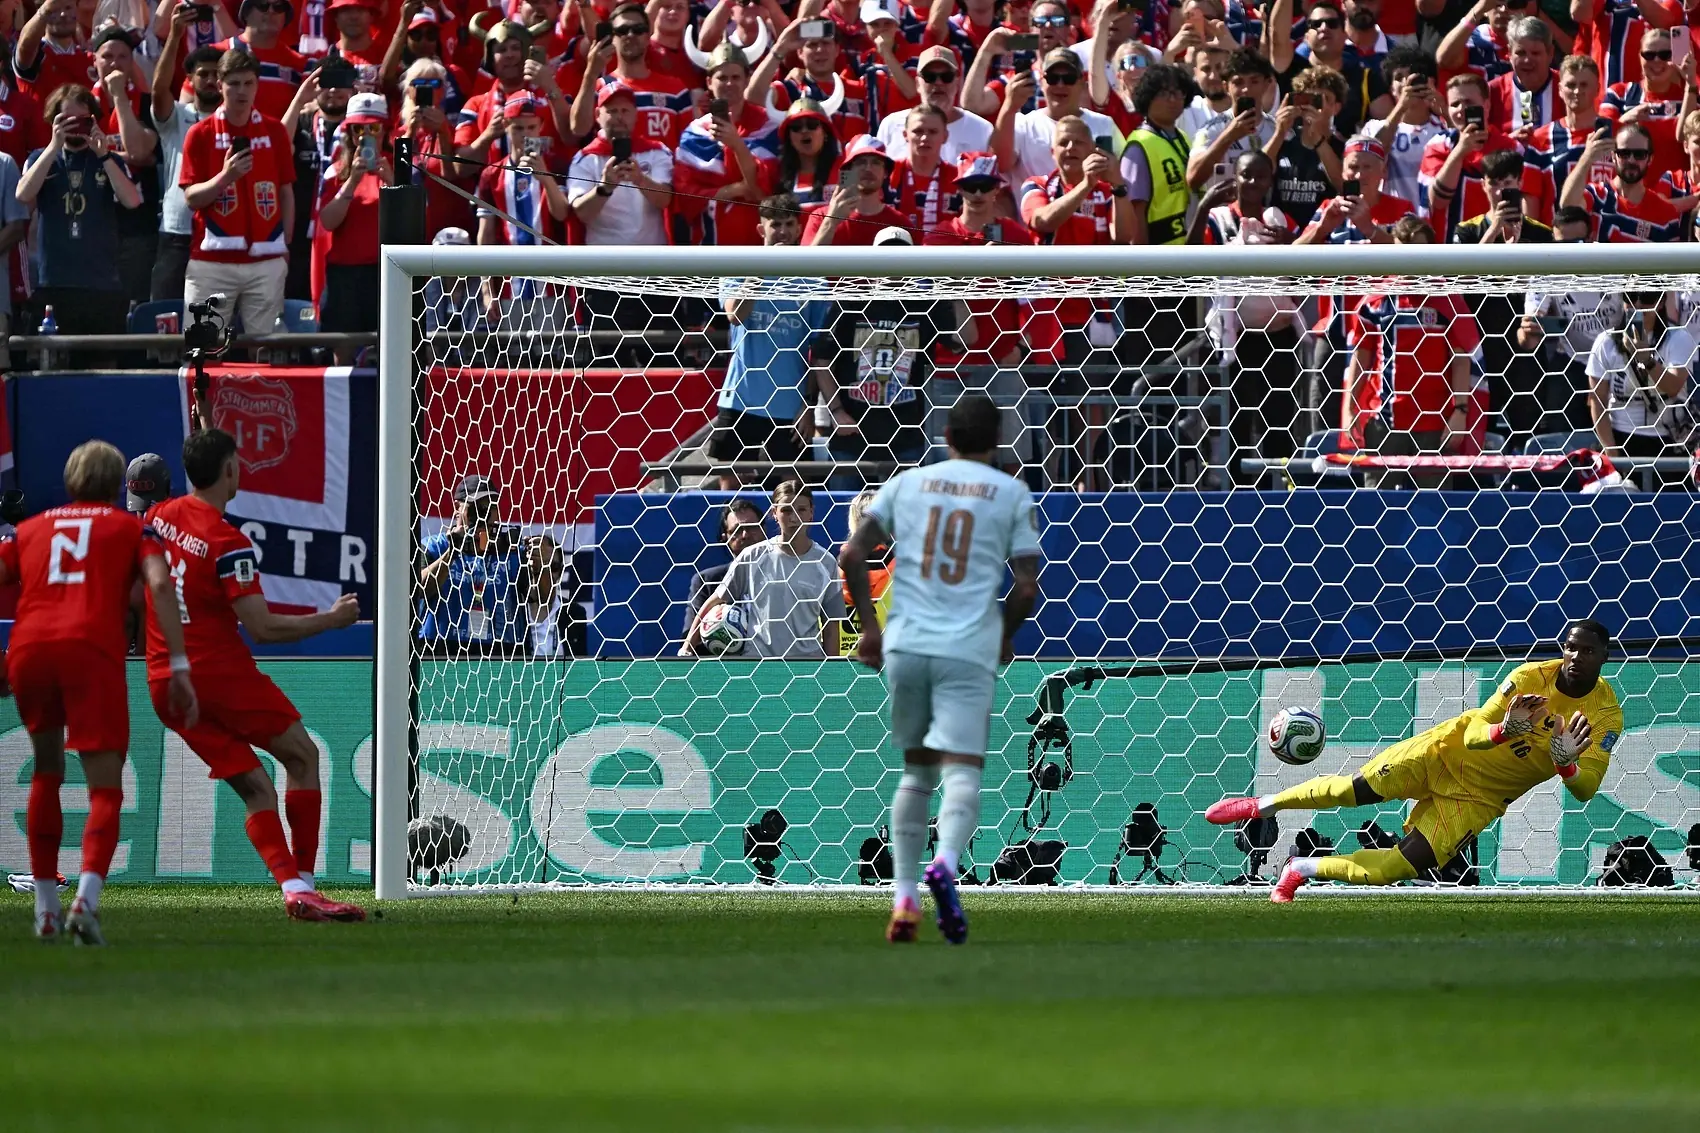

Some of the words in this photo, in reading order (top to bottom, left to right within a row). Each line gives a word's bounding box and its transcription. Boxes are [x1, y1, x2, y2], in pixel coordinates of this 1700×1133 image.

[647, 111, 671, 137] 20
[48, 518, 93, 585] 2
[921, 505, 975, 586] 19
[1509, 738, 1533, 761] 16
